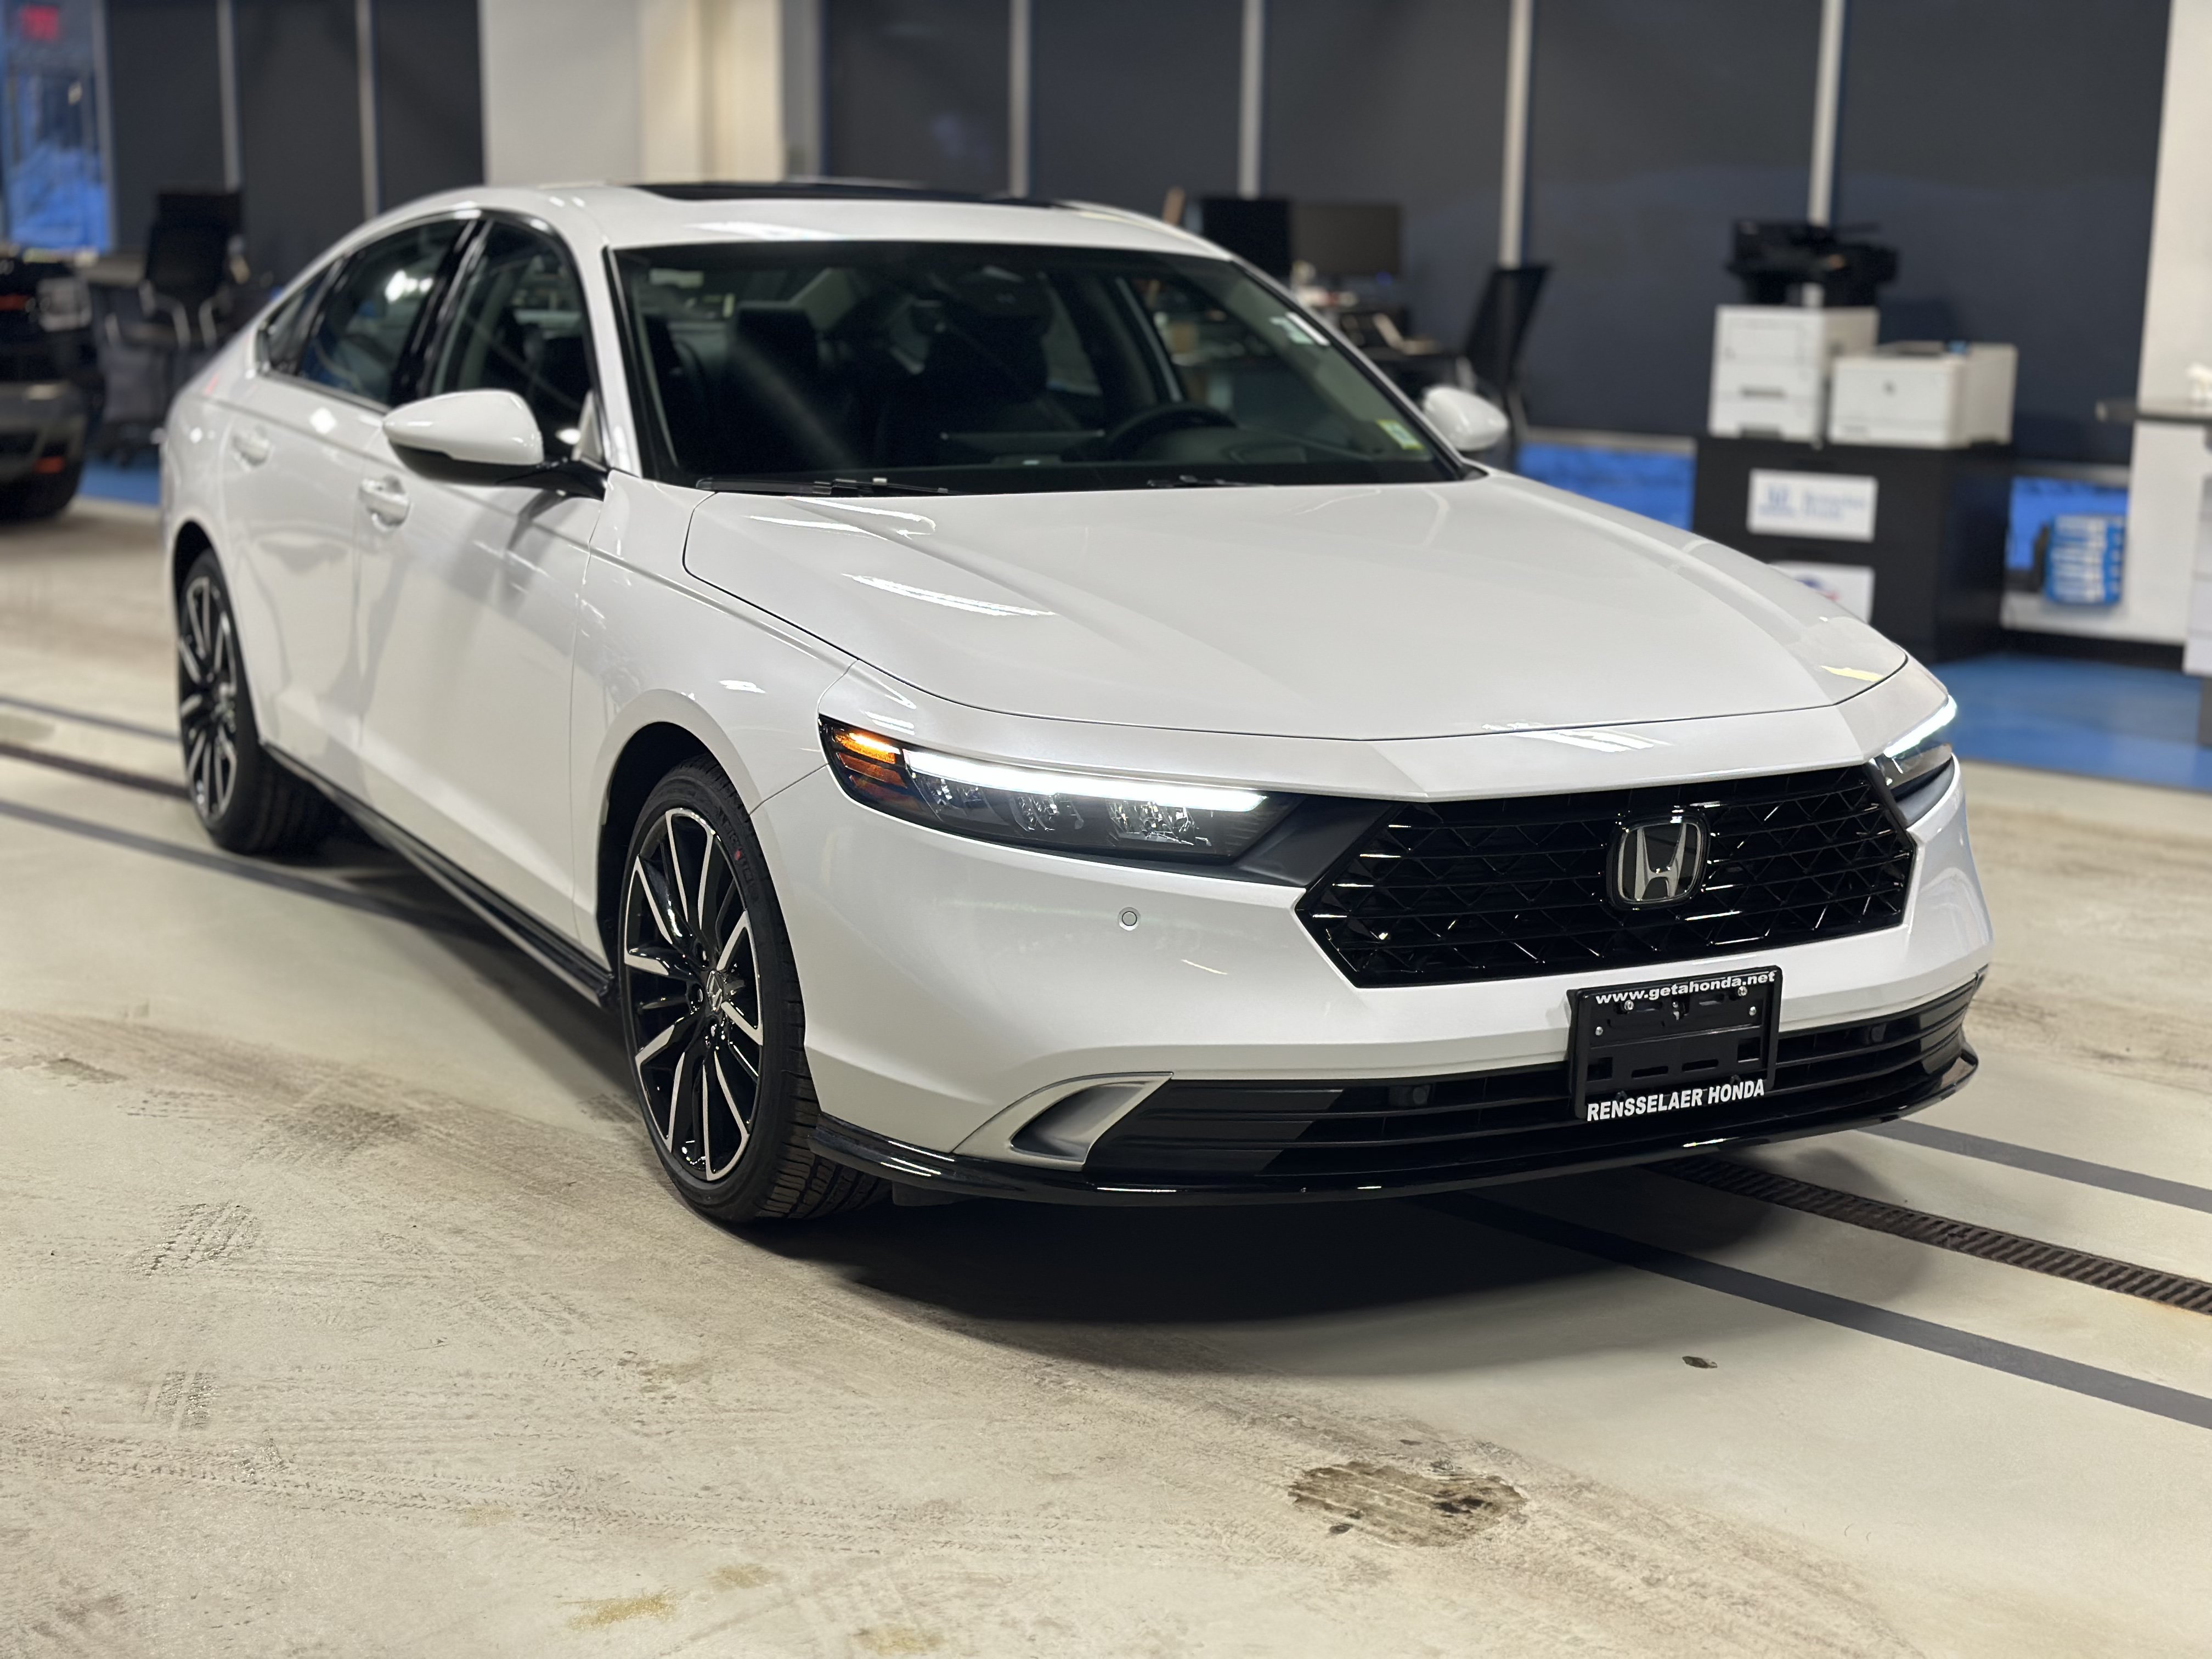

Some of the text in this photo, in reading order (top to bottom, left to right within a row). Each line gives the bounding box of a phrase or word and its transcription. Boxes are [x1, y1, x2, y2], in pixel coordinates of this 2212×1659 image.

[1595, 972, 1775, 1004] www.getahonda.net
[1587, 1079, 1764, 1121] RENSSELAER HONDA
